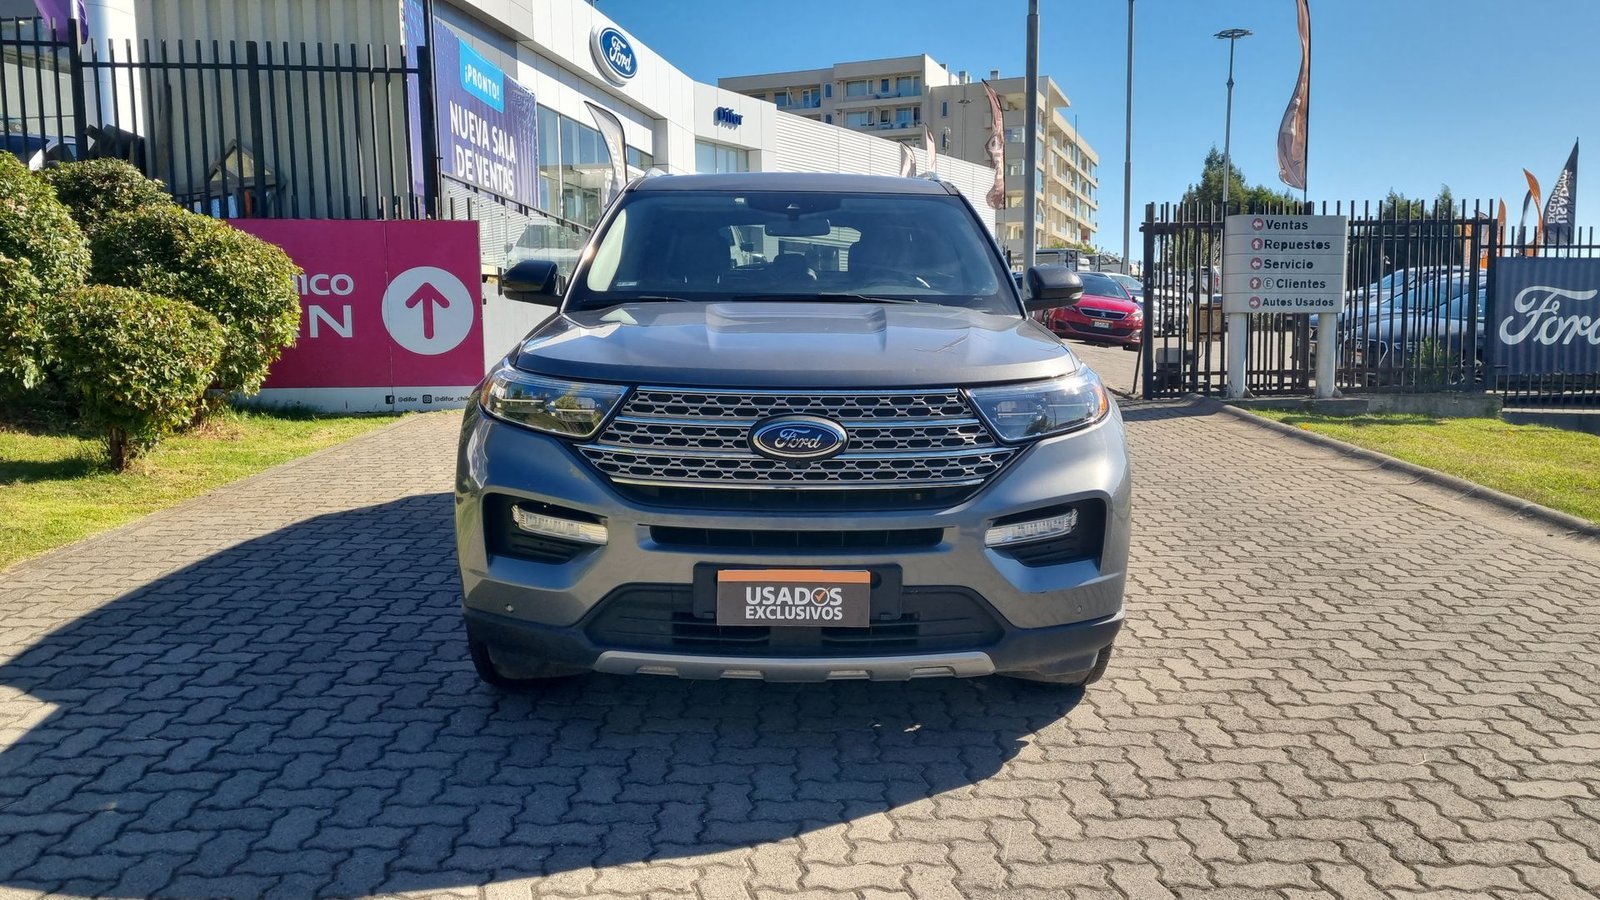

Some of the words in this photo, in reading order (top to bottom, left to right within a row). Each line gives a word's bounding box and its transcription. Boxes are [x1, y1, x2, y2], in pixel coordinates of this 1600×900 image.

[609, 36, 632, 72] Ford
[464, 63, 500, 101] ¡PRONTO!
[449, 100, 490, 151] NUEVA
[492, 125, 516, 164] SALA
[455, 144, 474, 181] DE
[474, 152, 515, 197] VENTAS
[1266, 219, 1309, 230] Ventas
[1264, 239, 1331, 252] Repuestos
[1264, 259, 1314, 269] Servicio
[1276, 278, 1326, 289] Clientes
[1262, 298, 1293, 307] Autos
[1295, 298, 1334, 307] Usados
[774, 428, 823, 450] Ford
[745, 586, 843, 606] USADOS
[745, 605, 843, 620] EXCLUSIVOS
